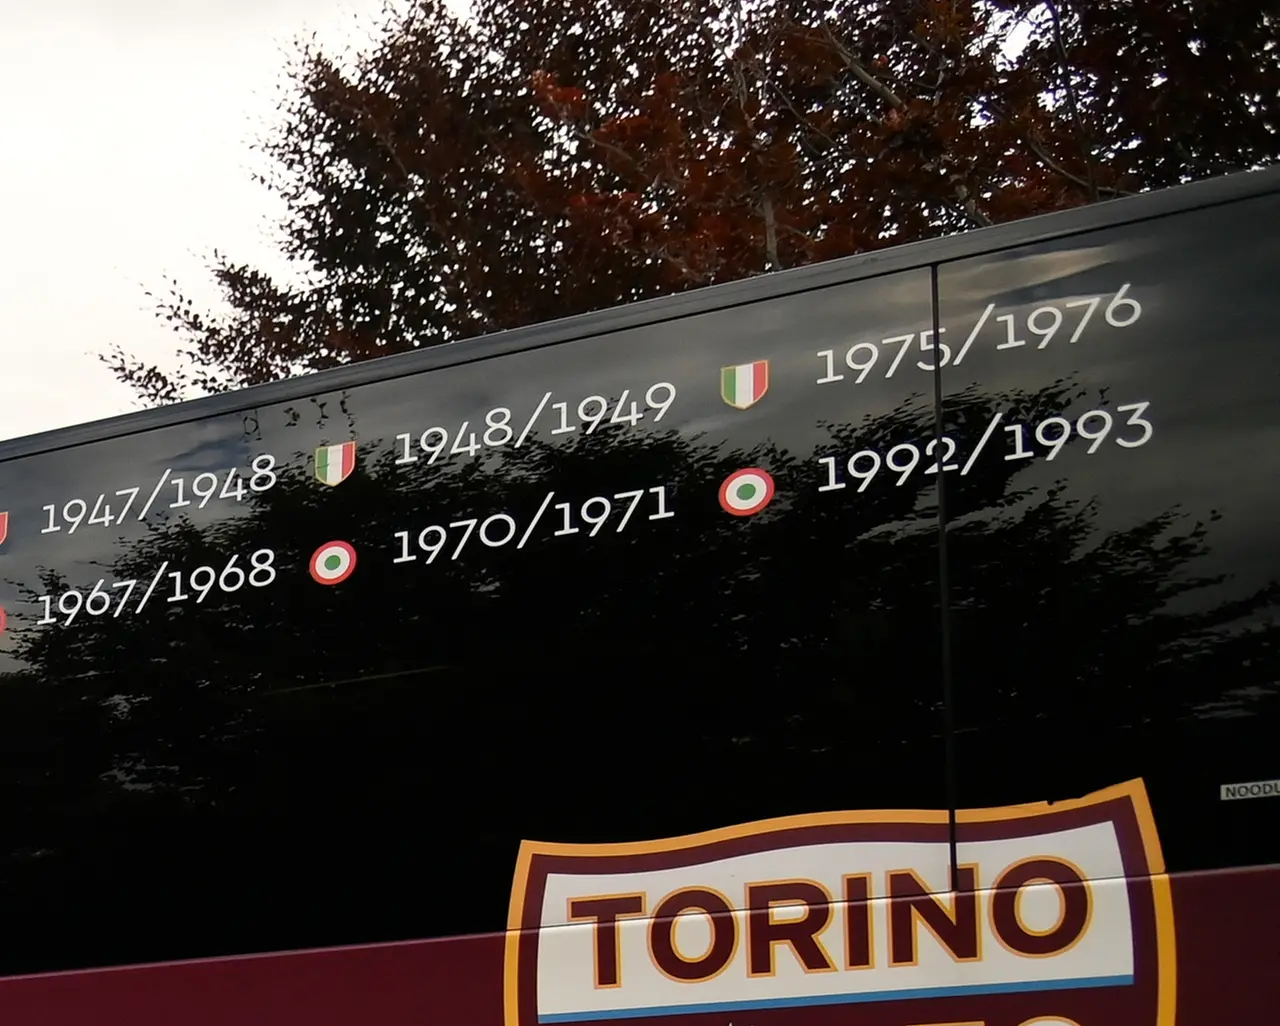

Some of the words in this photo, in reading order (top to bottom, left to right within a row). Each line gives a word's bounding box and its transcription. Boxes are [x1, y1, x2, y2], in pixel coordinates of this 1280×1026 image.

[815, 282, 1144, 386] 1975/1976
[393, 381, 678, 466] 1948/1949
[816, 401, 1154, 494] 1992/1993
[40, 455, 278, 534] 1947/1948
[392, 484, 676, 566] 1970/1971
[36, 548, 278, 626] 1967/1968
[566, 855, 1093, 990] TORINO
